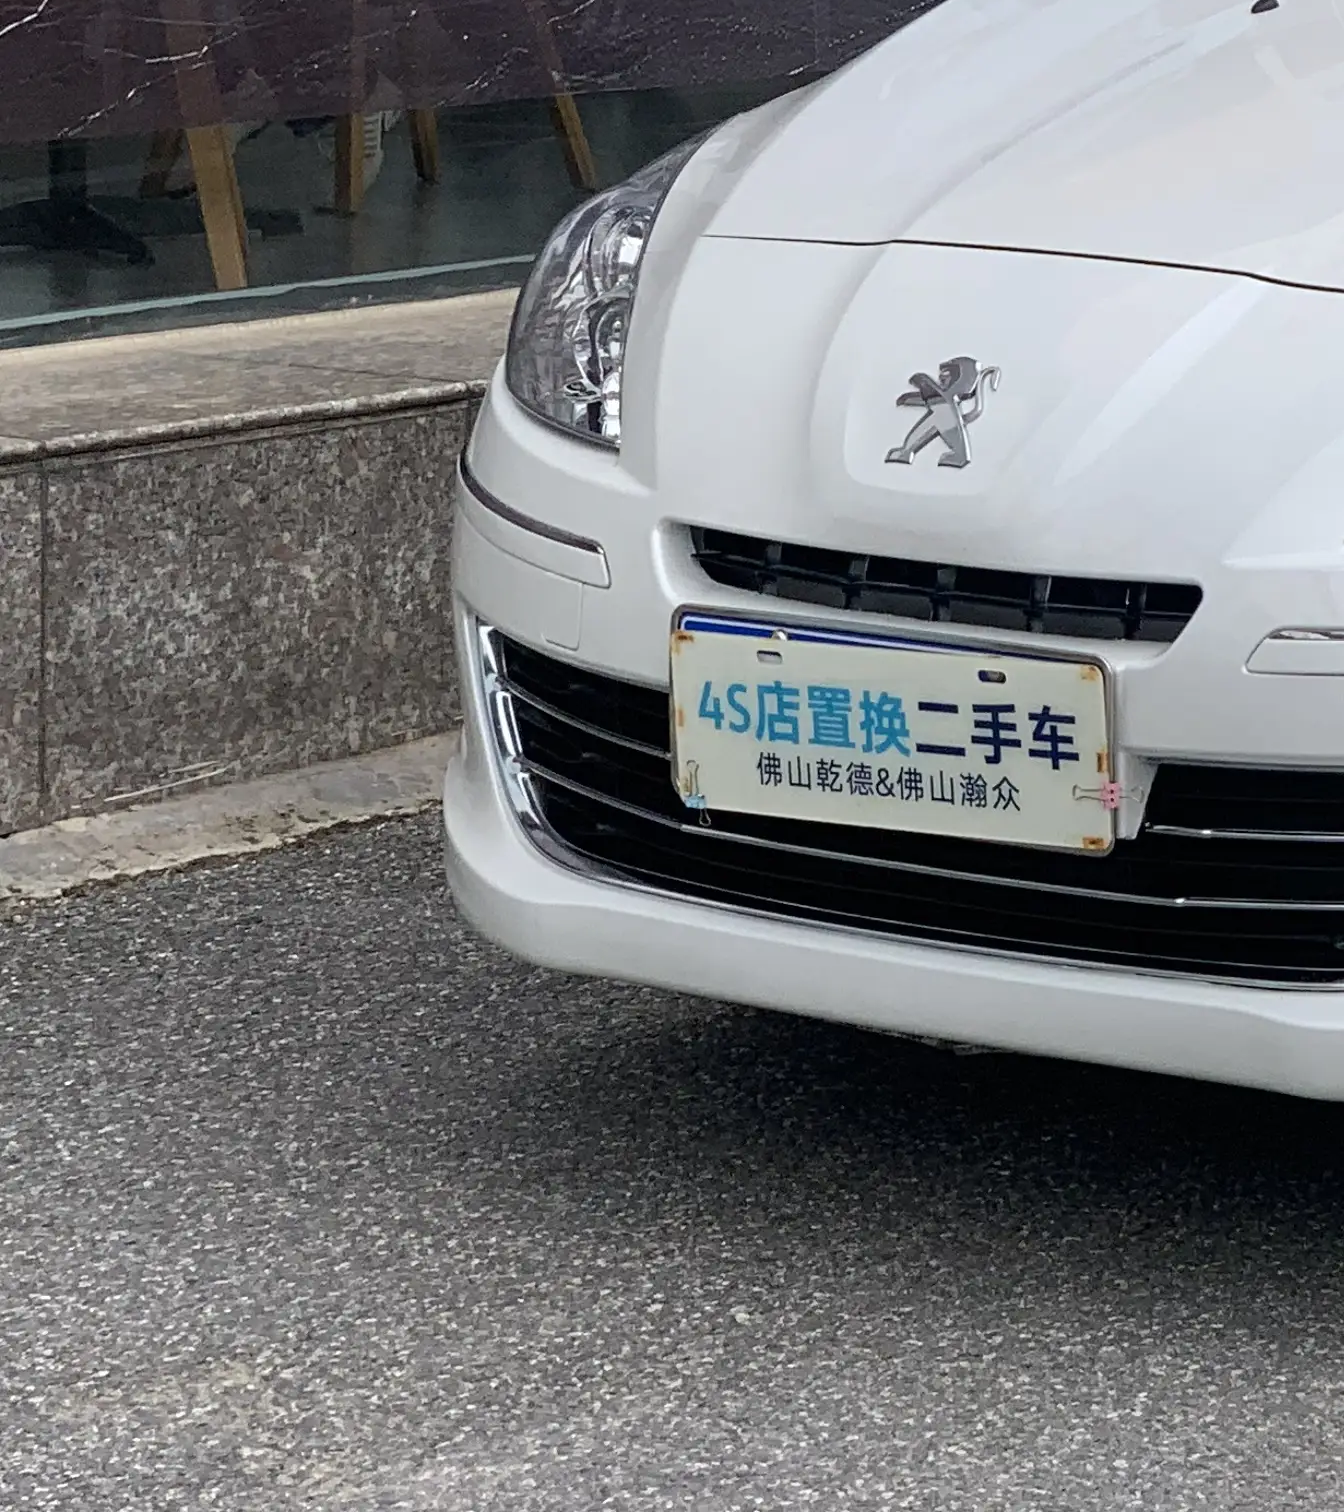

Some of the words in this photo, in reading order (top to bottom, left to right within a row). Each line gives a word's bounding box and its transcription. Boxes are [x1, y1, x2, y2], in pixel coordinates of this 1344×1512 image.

[698, 680, 1081, 770] 4S店置换二手车
[756, 751, 1022, 812] 佛山乾德&佛山瀚众
